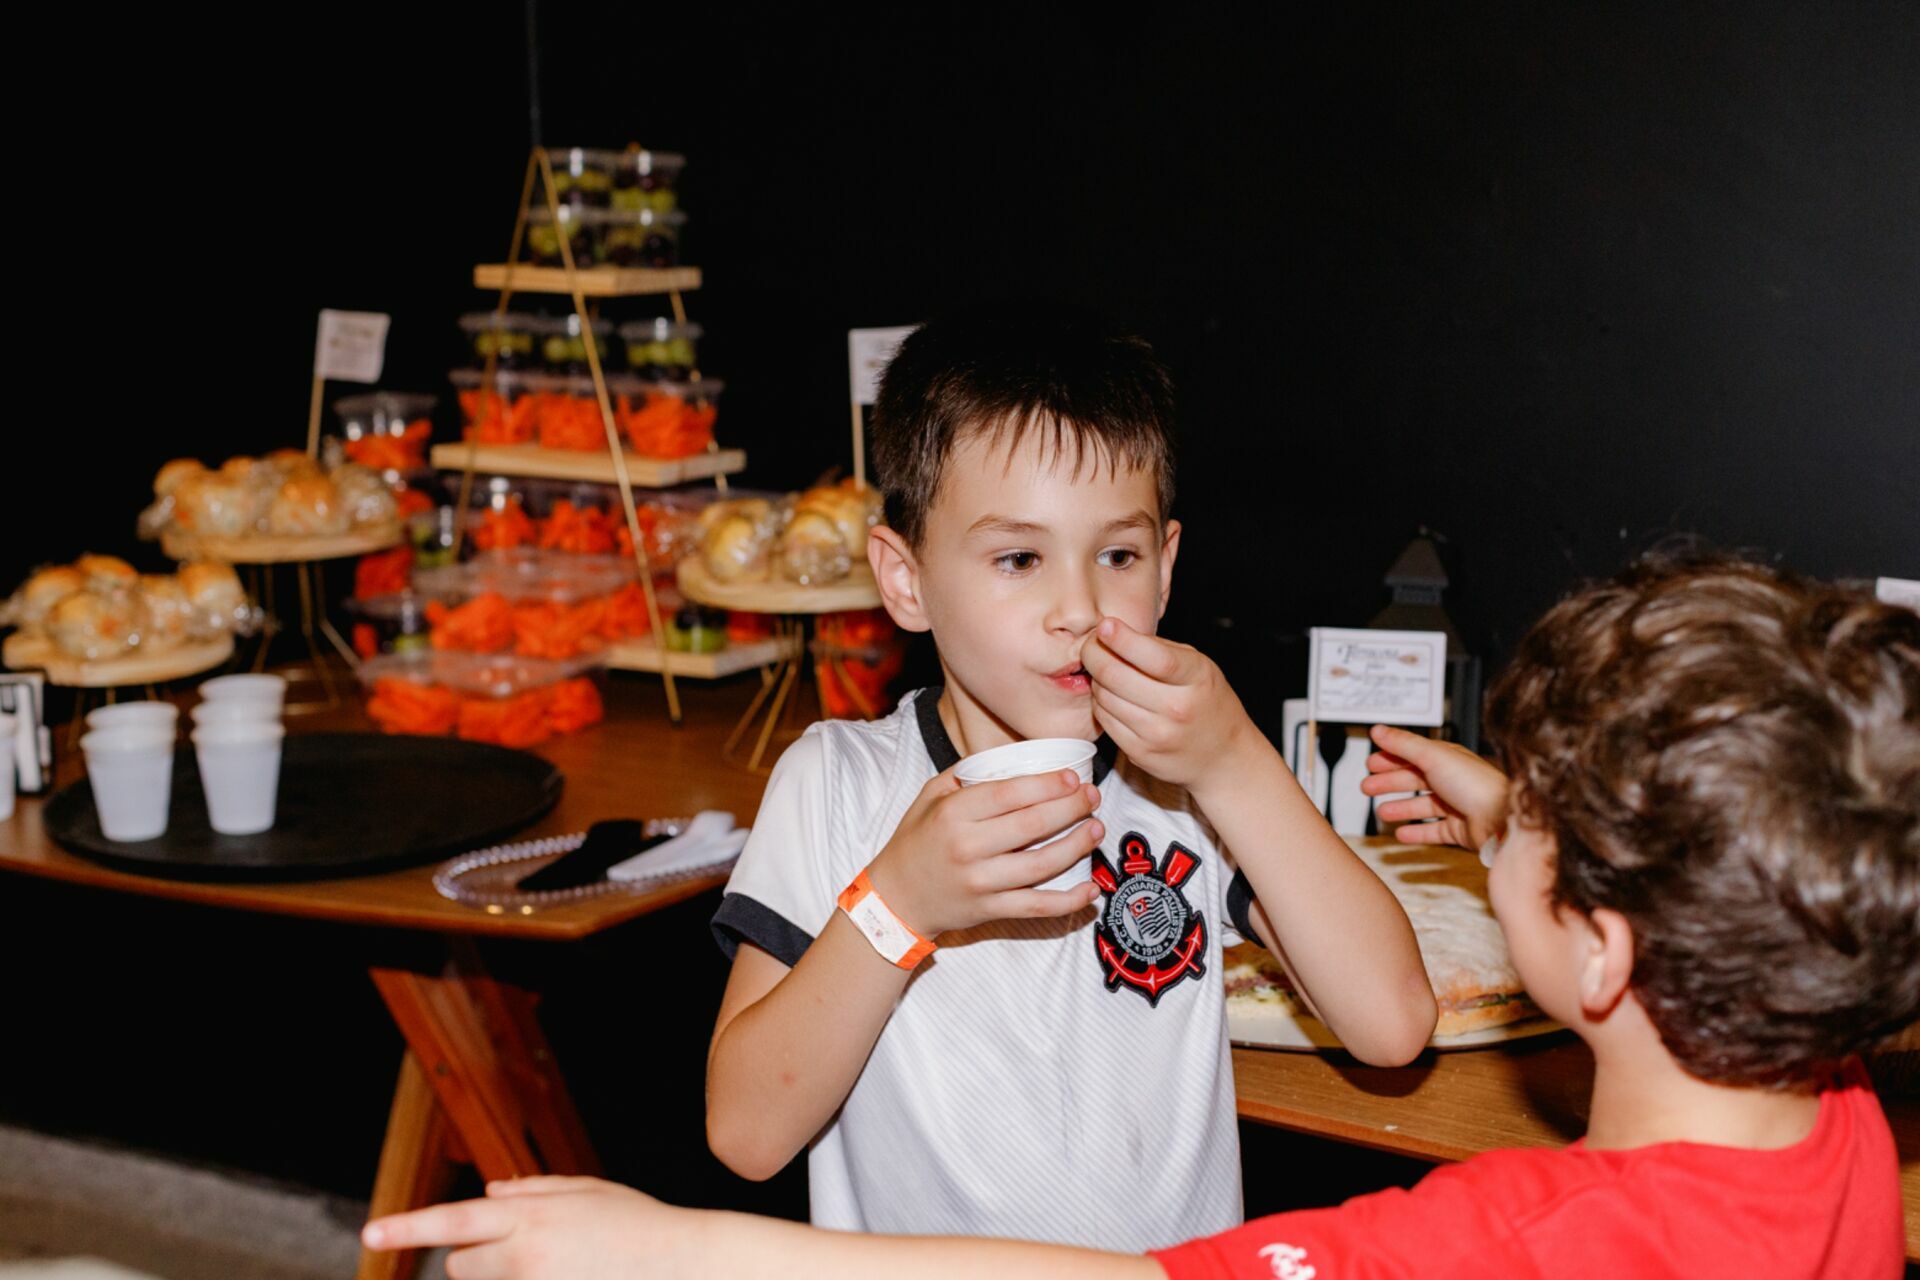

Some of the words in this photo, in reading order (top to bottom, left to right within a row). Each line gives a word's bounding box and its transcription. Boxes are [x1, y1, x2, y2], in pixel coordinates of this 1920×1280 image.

[1114, 882, 1161, 925] CORINTHIANS
[1161, 890, 1179, 939] PAULISTA
[1142, 946, 1163, 956] 1910
